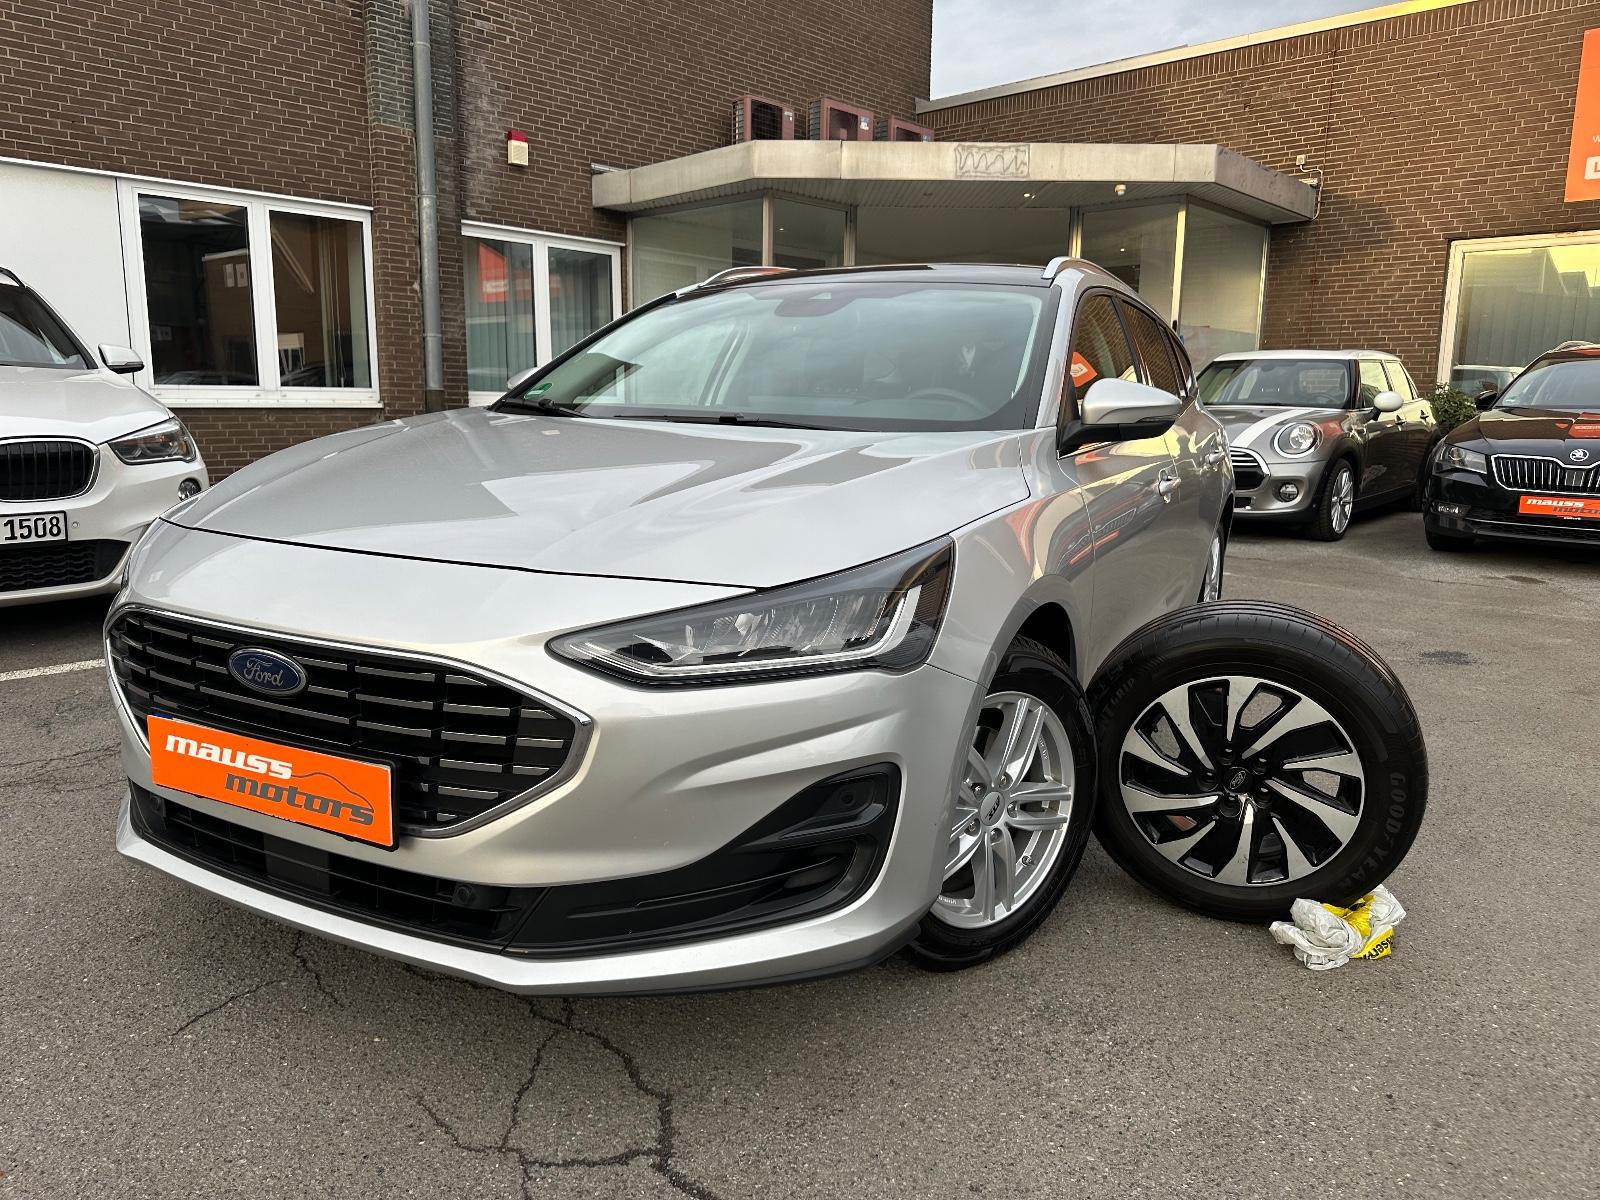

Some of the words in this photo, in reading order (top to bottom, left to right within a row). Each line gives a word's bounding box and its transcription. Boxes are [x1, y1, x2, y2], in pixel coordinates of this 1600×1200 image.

[1526, 498, 1585, 508] mauss
[3, 516, 61, 540] 1508
[243, 657, 284, 687] Ford
[165, 734, 293, 780] mauss
[225, 772, 375, 827] motors
